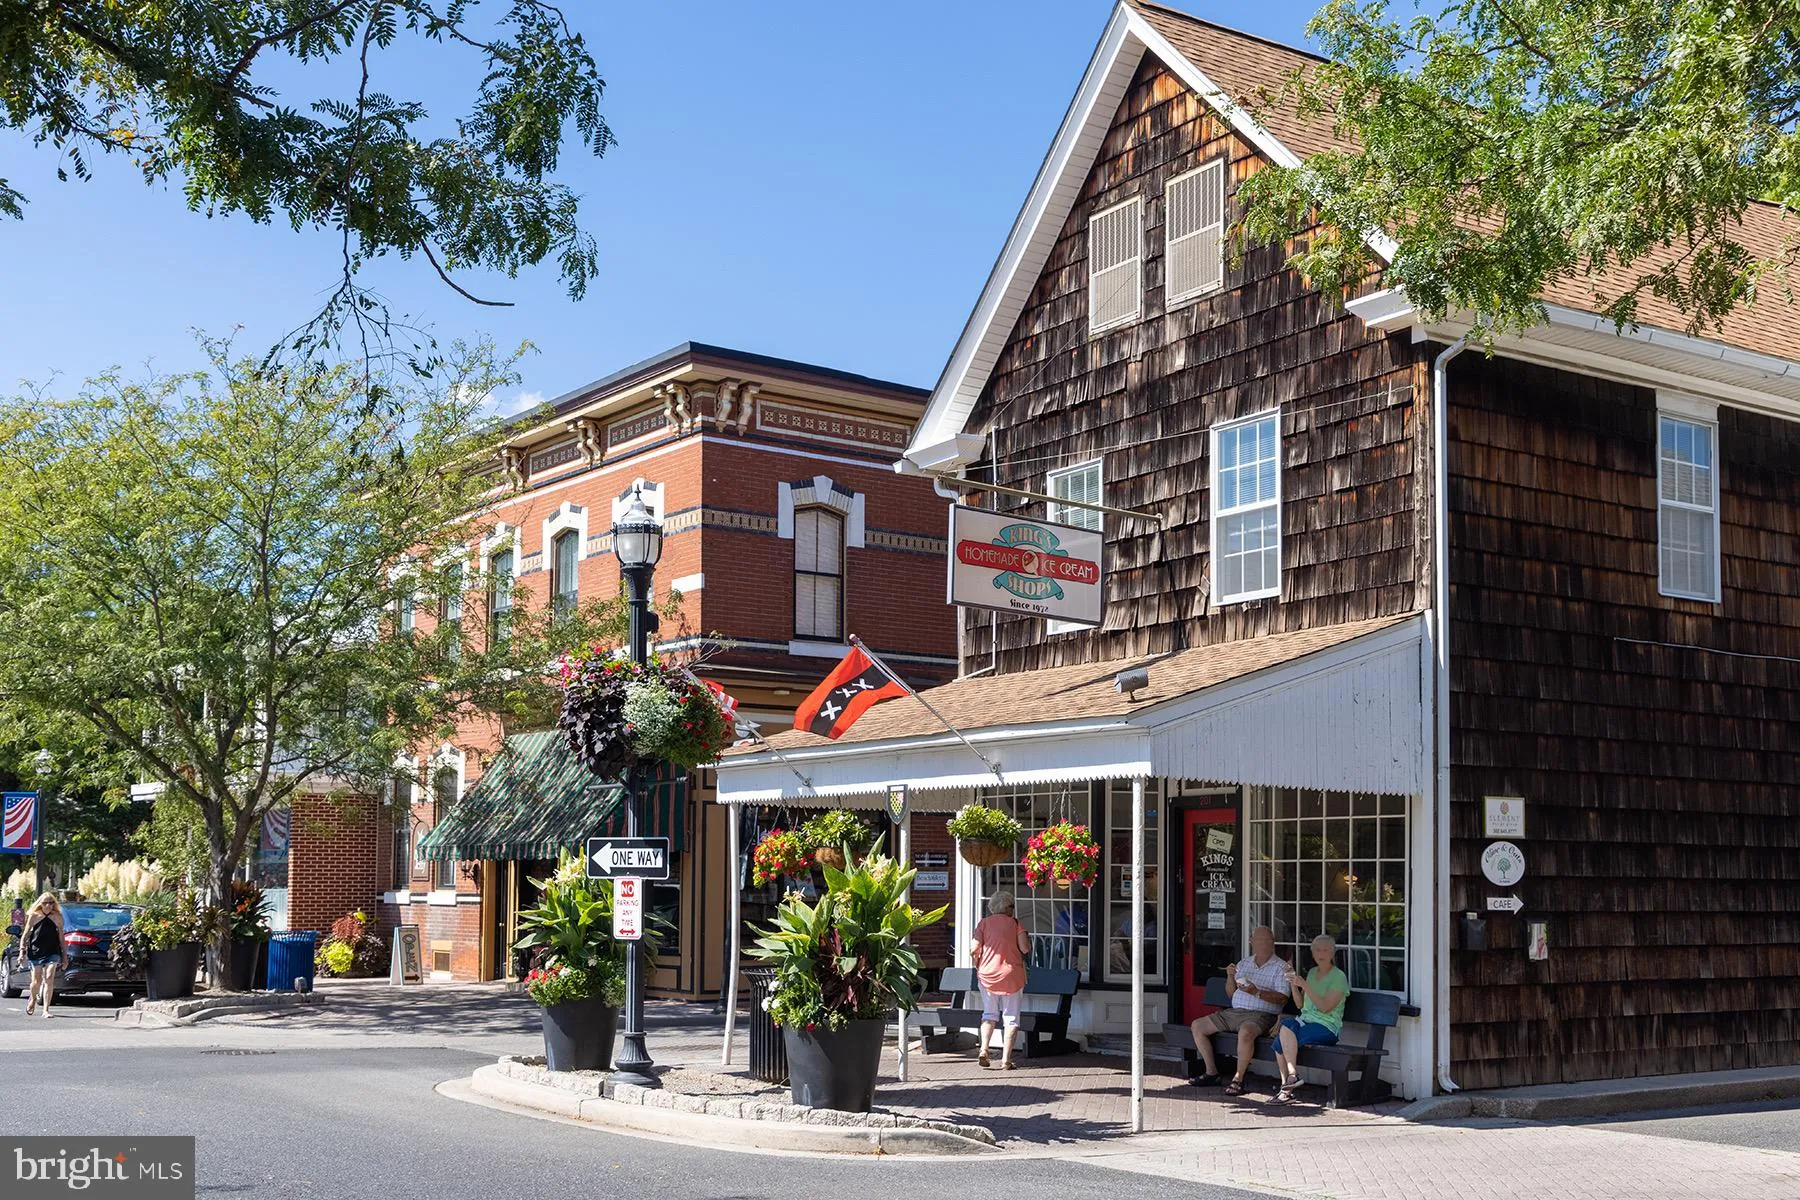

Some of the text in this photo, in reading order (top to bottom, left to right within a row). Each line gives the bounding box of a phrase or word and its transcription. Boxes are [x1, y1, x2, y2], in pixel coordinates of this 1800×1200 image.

[964, 546, 1094, 580] HOMEMADE ICE CREAM
[1008, 574, 1051, 596] SHOPS
[1009, 599, 1030, 609] Since
[611, 850, 660, 866] ONE WAY
[1200, 853, 1234, 867] KINGS
[1209, 872, 1225, 881] ICE
[621, 883, 635, 893] NO
[1201, 880, 1232, 889] CREAM
[616, 899, 639, 907] PARKING
[1493, 900, 1512, 909] CAFE
